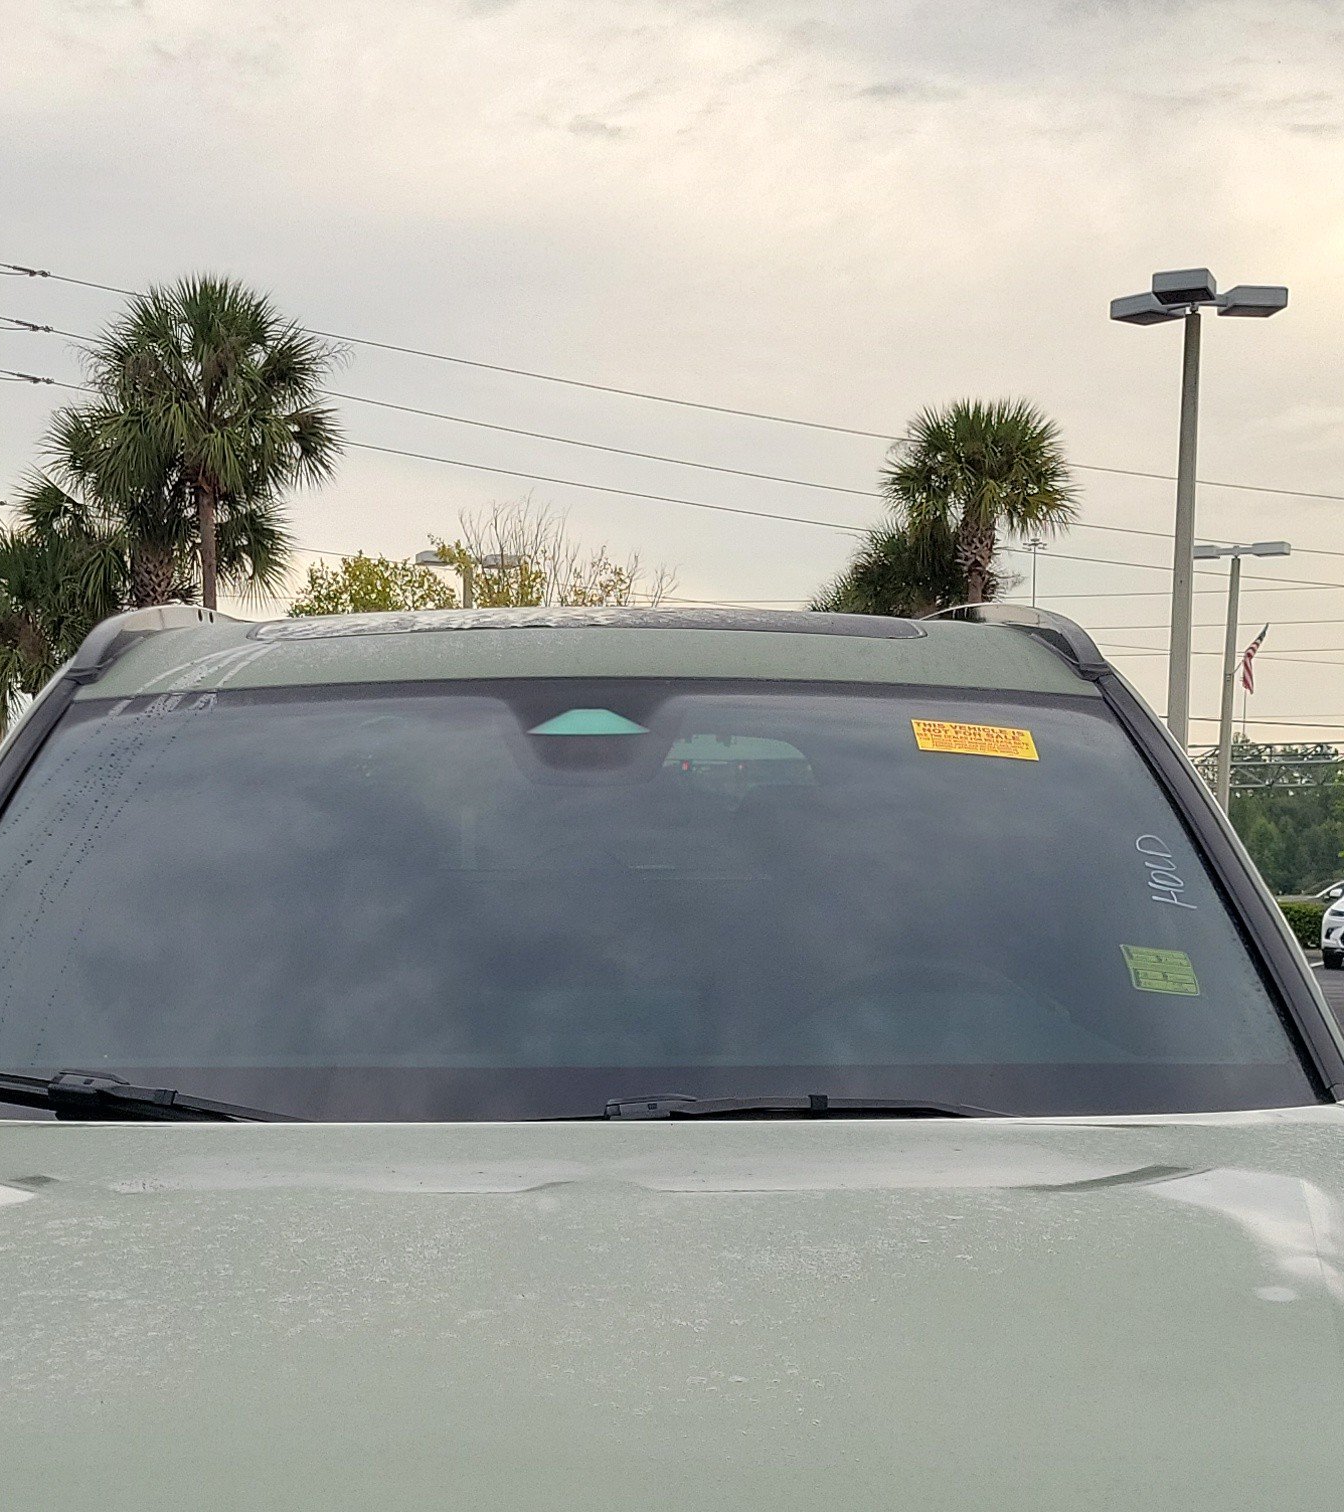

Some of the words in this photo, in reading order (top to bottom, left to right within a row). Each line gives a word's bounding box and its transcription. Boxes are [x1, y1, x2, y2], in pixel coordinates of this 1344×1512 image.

[949, 724, 1007, 734] VEHICLE
[954, 729, 981, 737] FOR
[984, 732, 1020, 740] SALE
[1135, 834, 1198, 909] HOLD
